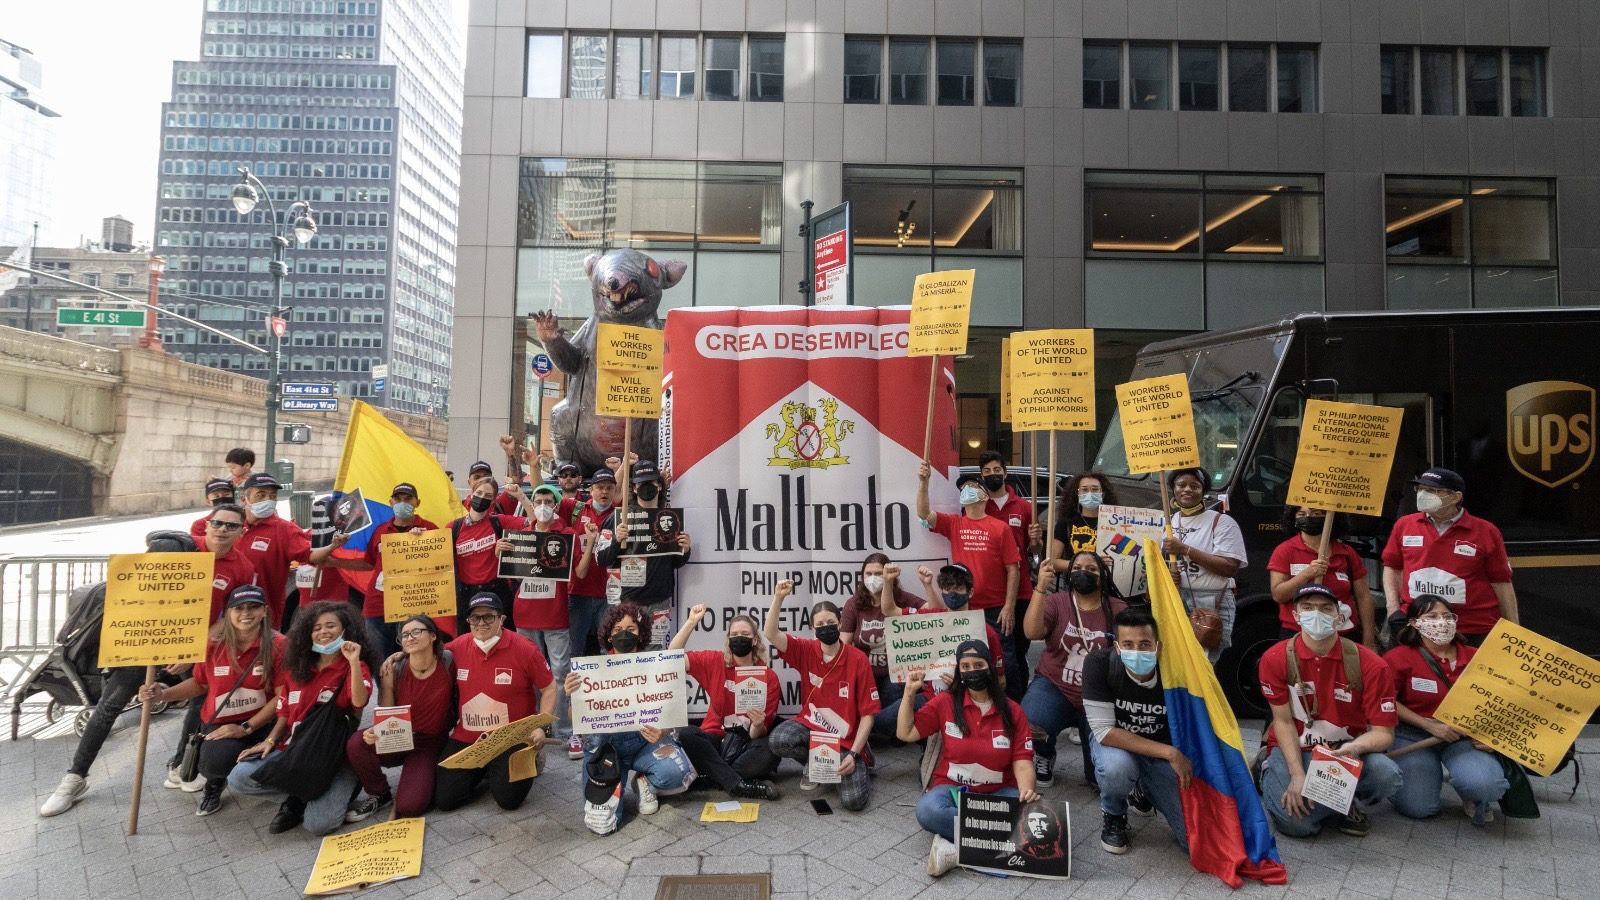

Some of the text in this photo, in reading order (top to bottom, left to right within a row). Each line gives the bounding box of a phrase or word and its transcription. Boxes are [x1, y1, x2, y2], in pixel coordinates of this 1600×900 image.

[926, 280, 967, 289] GLOBALIZAN
[83, 312, 120, 323] E 41 St
[624, 332, 640, 340] THE
[706, 331, 909, 352] CREA DESEMPLEO
[611, 340, 653, 351] WORKERS
[616, 350, 647, 359] UNITED
[620, 377, 641, 385] WILL
[611, 385, 638, 393] NEVER
[1129, 385, 1170, 396] WORKERS
[608, 394, 652, 404] DEFEATED!
[1133, 396, 1147, 404] THE
[1149, 391, 1183, 401] WORLD
[1136, 402, 1169, 412] UNITED
[1329, 411, 1356, 419] PHILIP
[1358, 414, 1389, 423] MORRIS
[1318, 418, 1386, 430] INTERNACIONAL
[1140, 431, 1172, 441] AGAINST
[1324, 426, 1359, 435] EMPLEO
[1361, 430, 1390, 438] QUIERE
[1131, 438, 1186, 450] OUTSOURCING
[1322, 434, 1370, 444] TERCERIZAR
[1513, 413, 1590, 471] ups
[1329, 466, 1347, 474] CON
[1310, 471, 1370, 483] MOVILIZACIÓN
[1321, 480, 1370, 491] TENDREMOS
[1325, 489, 1371, 498] ENFRENTAR
[714, 474, 911, 552] Maltrato
[1109, 514, 1163, 527] Solidaridad
[412, 537, 446, 546] DERECHO
[134, 563, 191, 571] WORKERS
[117, 573, 134, 581] OF
[161, 572, 206, 580] WORLD
[138, 583, 185, 591] UNITED
[524, 583, 549, 593] Maltrato
[1415, 580, 1455, 596] Maltrato
[110, 618, 202, 628] AGAINST UNJUST
[723, 607, 811, 631] RSETA
[892, 618, 969, 633] STUDENTS AND
[124, 629, 166, 637] FIRINGS
[151, 637, 194, 645] MORRIS
[893, 634, 971, 649] WORKERS UNITED
[896, 649, 957, 663] AGAINST EXPL
[1500, 633, 1600, 683] POR EL DERECHO
[572, 662, 599, 671] UNITED
[1502, 645, 1591, 689] A UN TRABAJO
[1520, 663, 1561, 687] DIGNO
[584, 672, 678, 693] SOLIDARITY WITH
[1529, 677, 1538, 687] Y
[585, 699, 629, 710] TOBACCO
[637, 691, 673, 703] WORKERS
[1470, 683, 1567, 735] POR EL FUTURO DE
[465, 713, 500, 727] Maltrato
[615, 711, 636, 719] PHILIP
[1130, 715, 1156, 725] THE
[1485, 700, 1537, 730] NUESTRAS
[1474, 705, 1537, 740] FAMILIAS EN
[1474, 714, 1528, 745] COLOMBIA
[1316, 769, 1348, 788] Maltrato
[1008, 856, 1025, 866] Che
